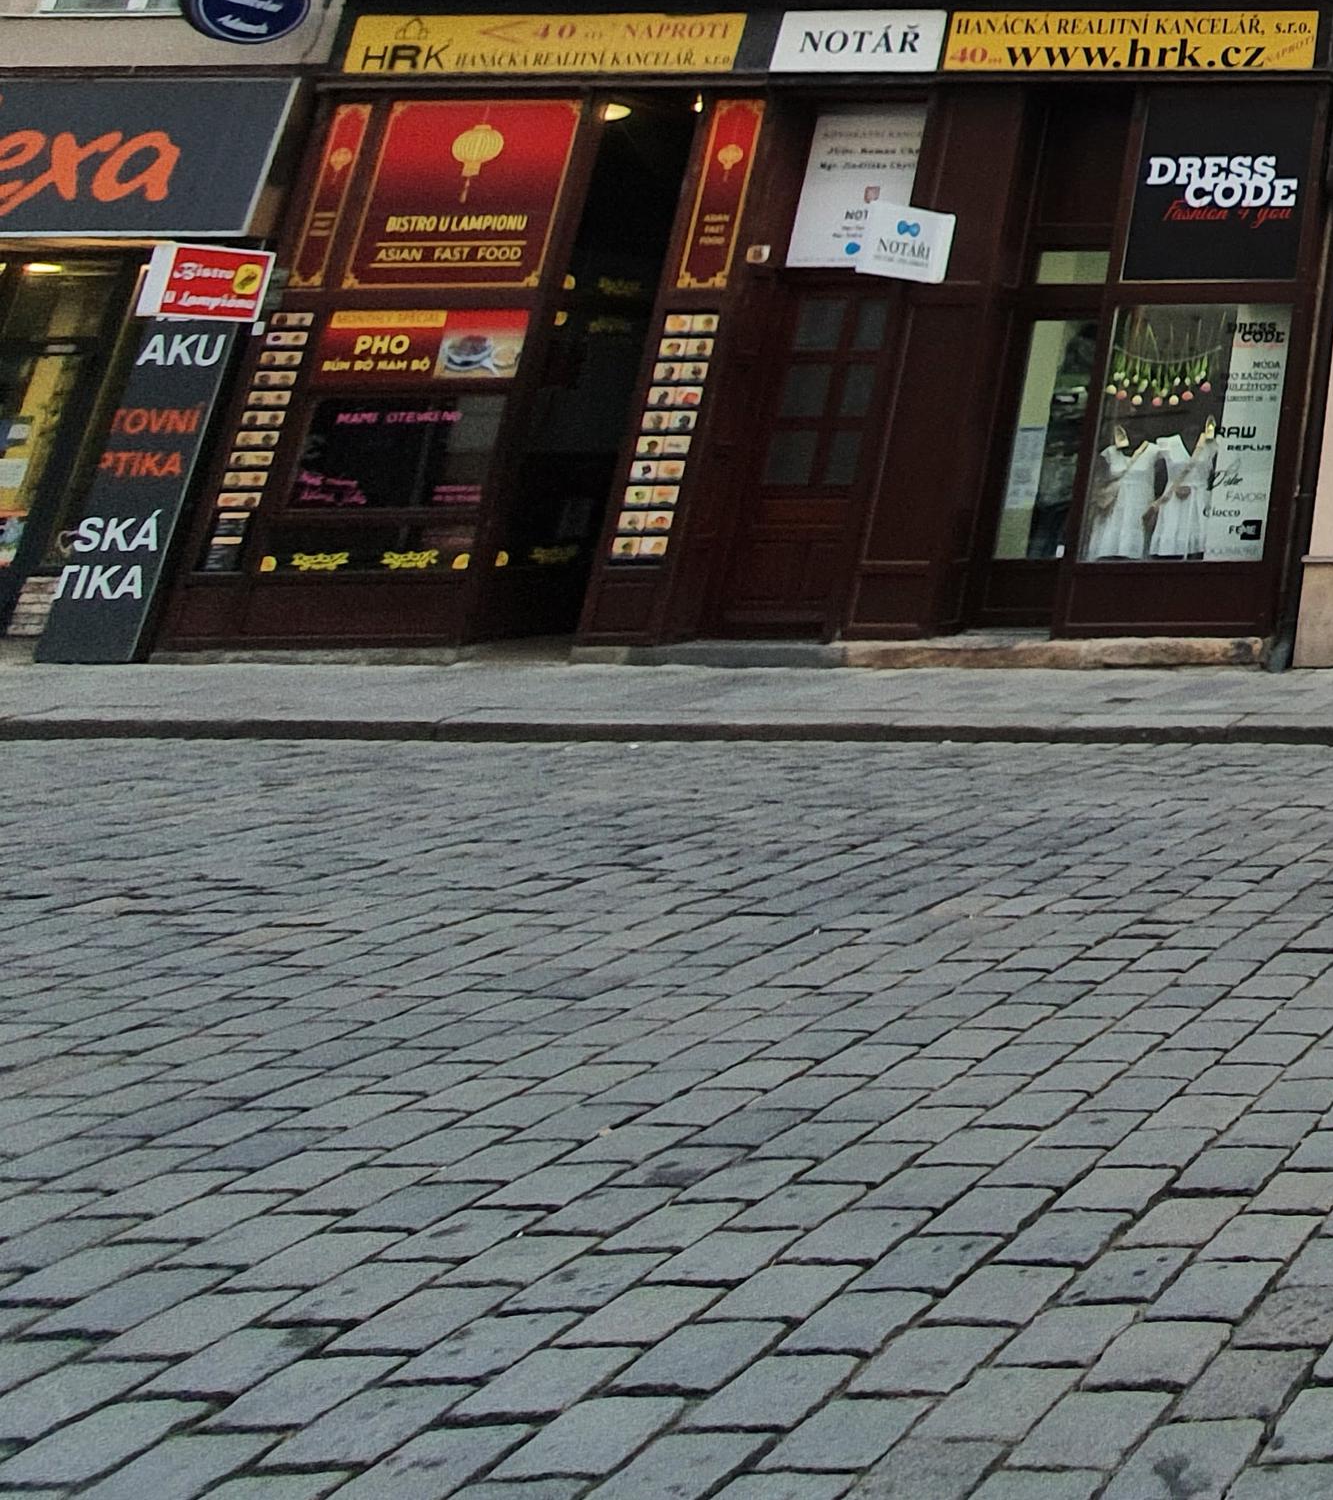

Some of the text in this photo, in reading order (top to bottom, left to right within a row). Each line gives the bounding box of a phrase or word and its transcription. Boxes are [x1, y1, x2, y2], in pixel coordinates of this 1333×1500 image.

[623, 21, 730, 40] NAPROTI
[955, 14, 1050, 35] HANÁCKÁ
[1057, 13, 1150, 35] REALITNÍ
[1274, 20, 1311, 34] s.r.o.
[799, 23, 920, 54] NOTÁŘ
[360, 38, 454, 71] HRK
[455, 50, 528, 68] HANÁCKÁ
[532, 49, 606, 68] REALITNÍ
[1006, 38, 1267, 69] www.hrk.cz
[1146, 155, 1277, 185] DRESS
[1184, 176, 1298, 208] CODE
[1163, 200, 1229, 222] Fashion
[385, 214, 529, 233] BISTRO U LAMPIONU
[375, 245, 523, 262] ASIAN FAST FOOD
[878, 237, 931, 261] NOTÁŘI
[353, 334, 411, 355] PHO
[1241, 331, 1285, 343] CODE
[135, 333, 227, 367] AKU
[1226, 444, 1273, 452] REPLUS
[72, 508, 164, 553] SKÁ
